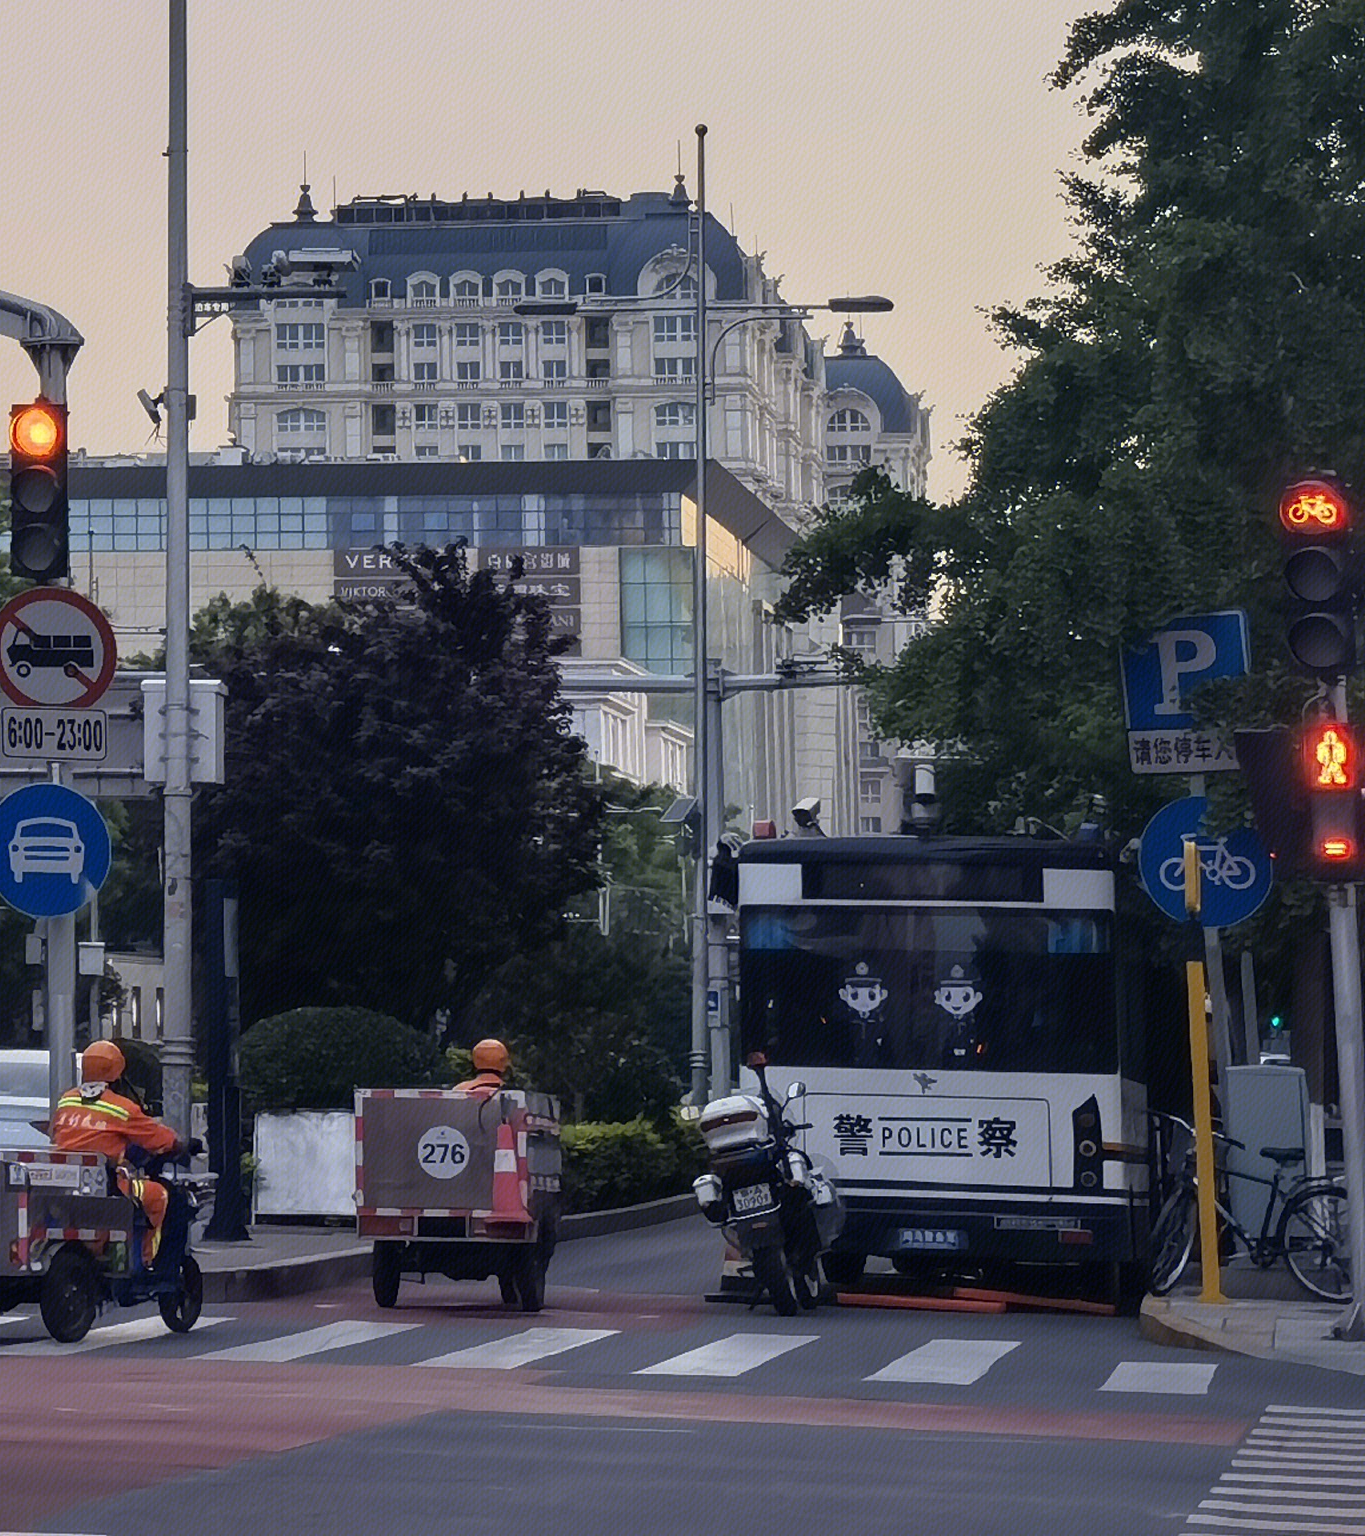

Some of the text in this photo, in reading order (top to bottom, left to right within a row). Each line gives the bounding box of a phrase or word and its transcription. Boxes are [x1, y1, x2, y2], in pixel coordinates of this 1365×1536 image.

[1149, 629, 1218, 716] P
[7, 715, 103, 753] 6:00-23:00
[421, 1143, 466, 1165] 276
[832, 1113, 1019, 1159] 警 POLICE 察
